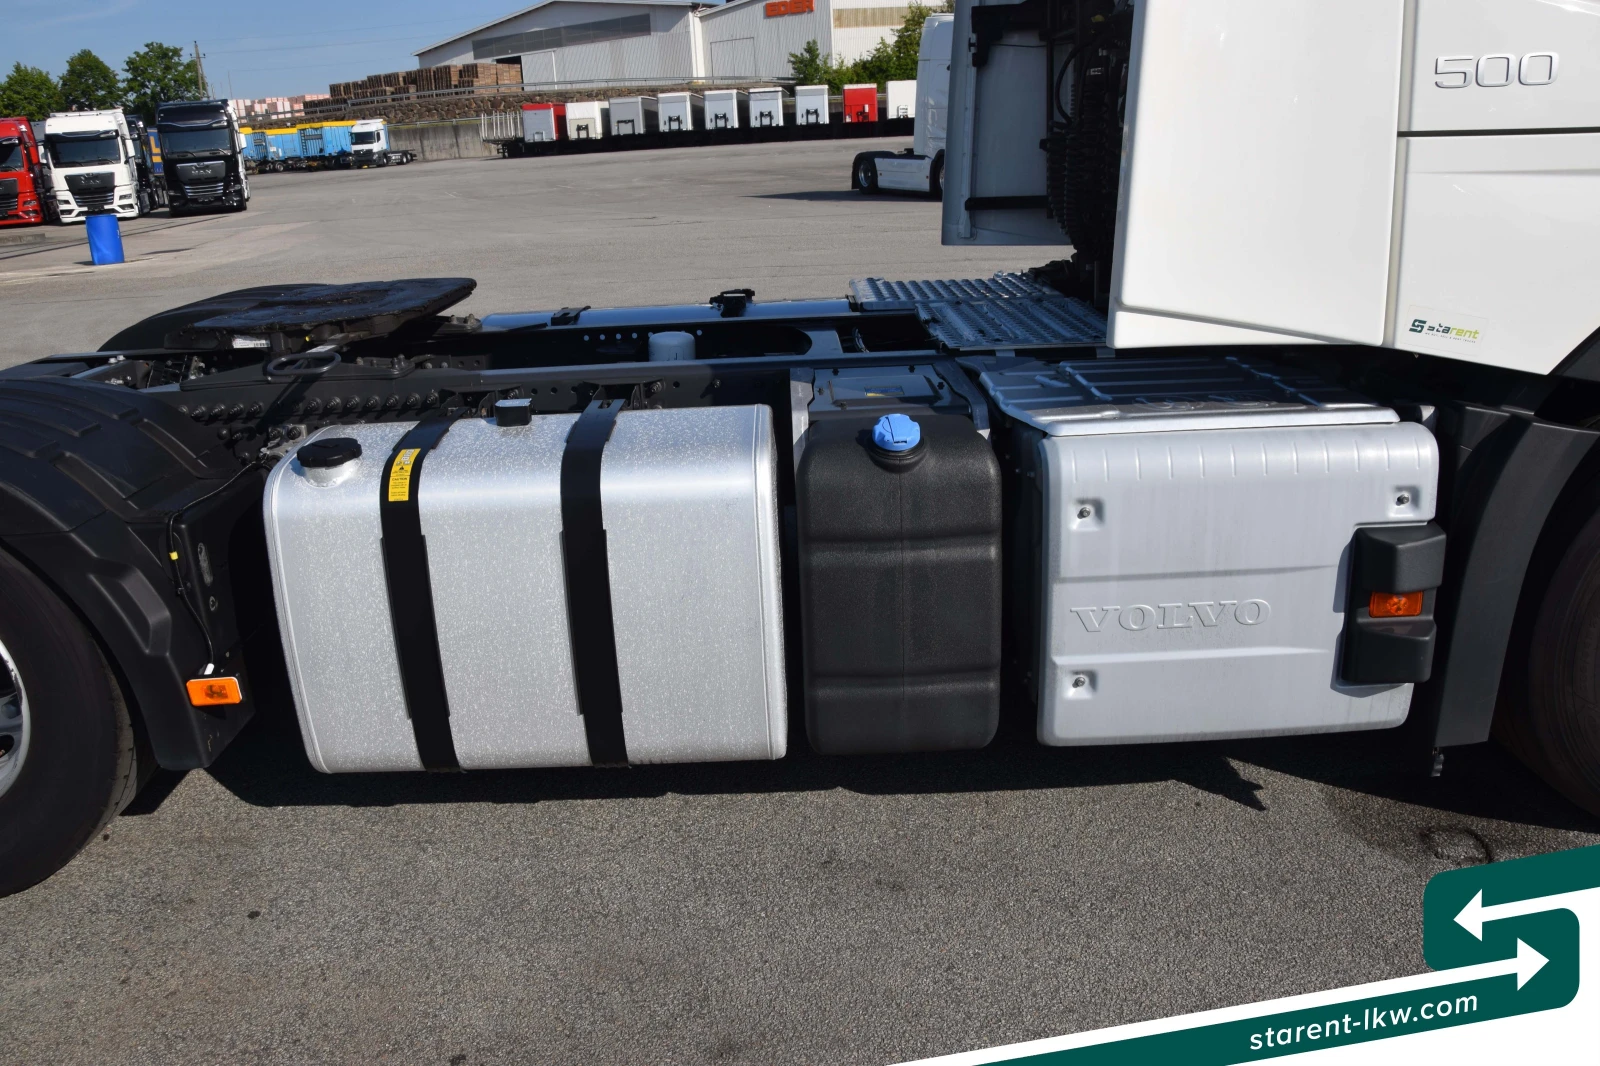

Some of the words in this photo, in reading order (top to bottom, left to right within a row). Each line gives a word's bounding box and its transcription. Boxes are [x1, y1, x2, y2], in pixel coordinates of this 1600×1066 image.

[765, 0, 814, 16] EDER
[1434, 53, 1560, 88] 500
[1070, 598, 1272, 632] VOLVO
